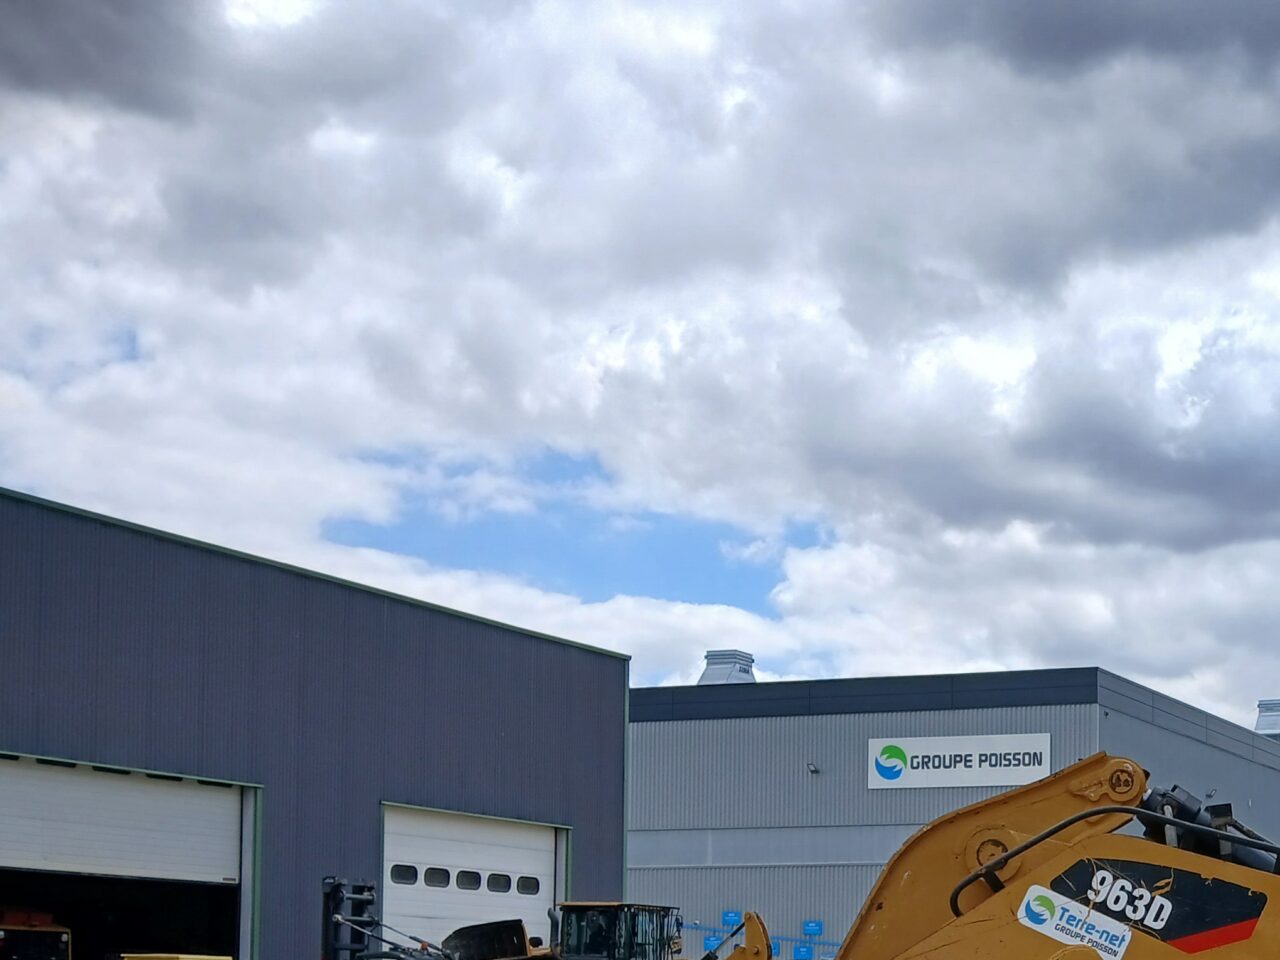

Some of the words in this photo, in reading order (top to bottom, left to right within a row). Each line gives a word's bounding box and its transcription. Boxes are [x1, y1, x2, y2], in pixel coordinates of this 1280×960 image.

[910, 754, 973, 770] GROUPE
[978, 751, 1043, 768] POISSON
[1087, 869, 1173, 930] 963D
[1054, 923, 1086, 942] GROUPE
[1086, 937, 1119, 958] POISSON
[1056, 906, 1127, 948] Terre-net
